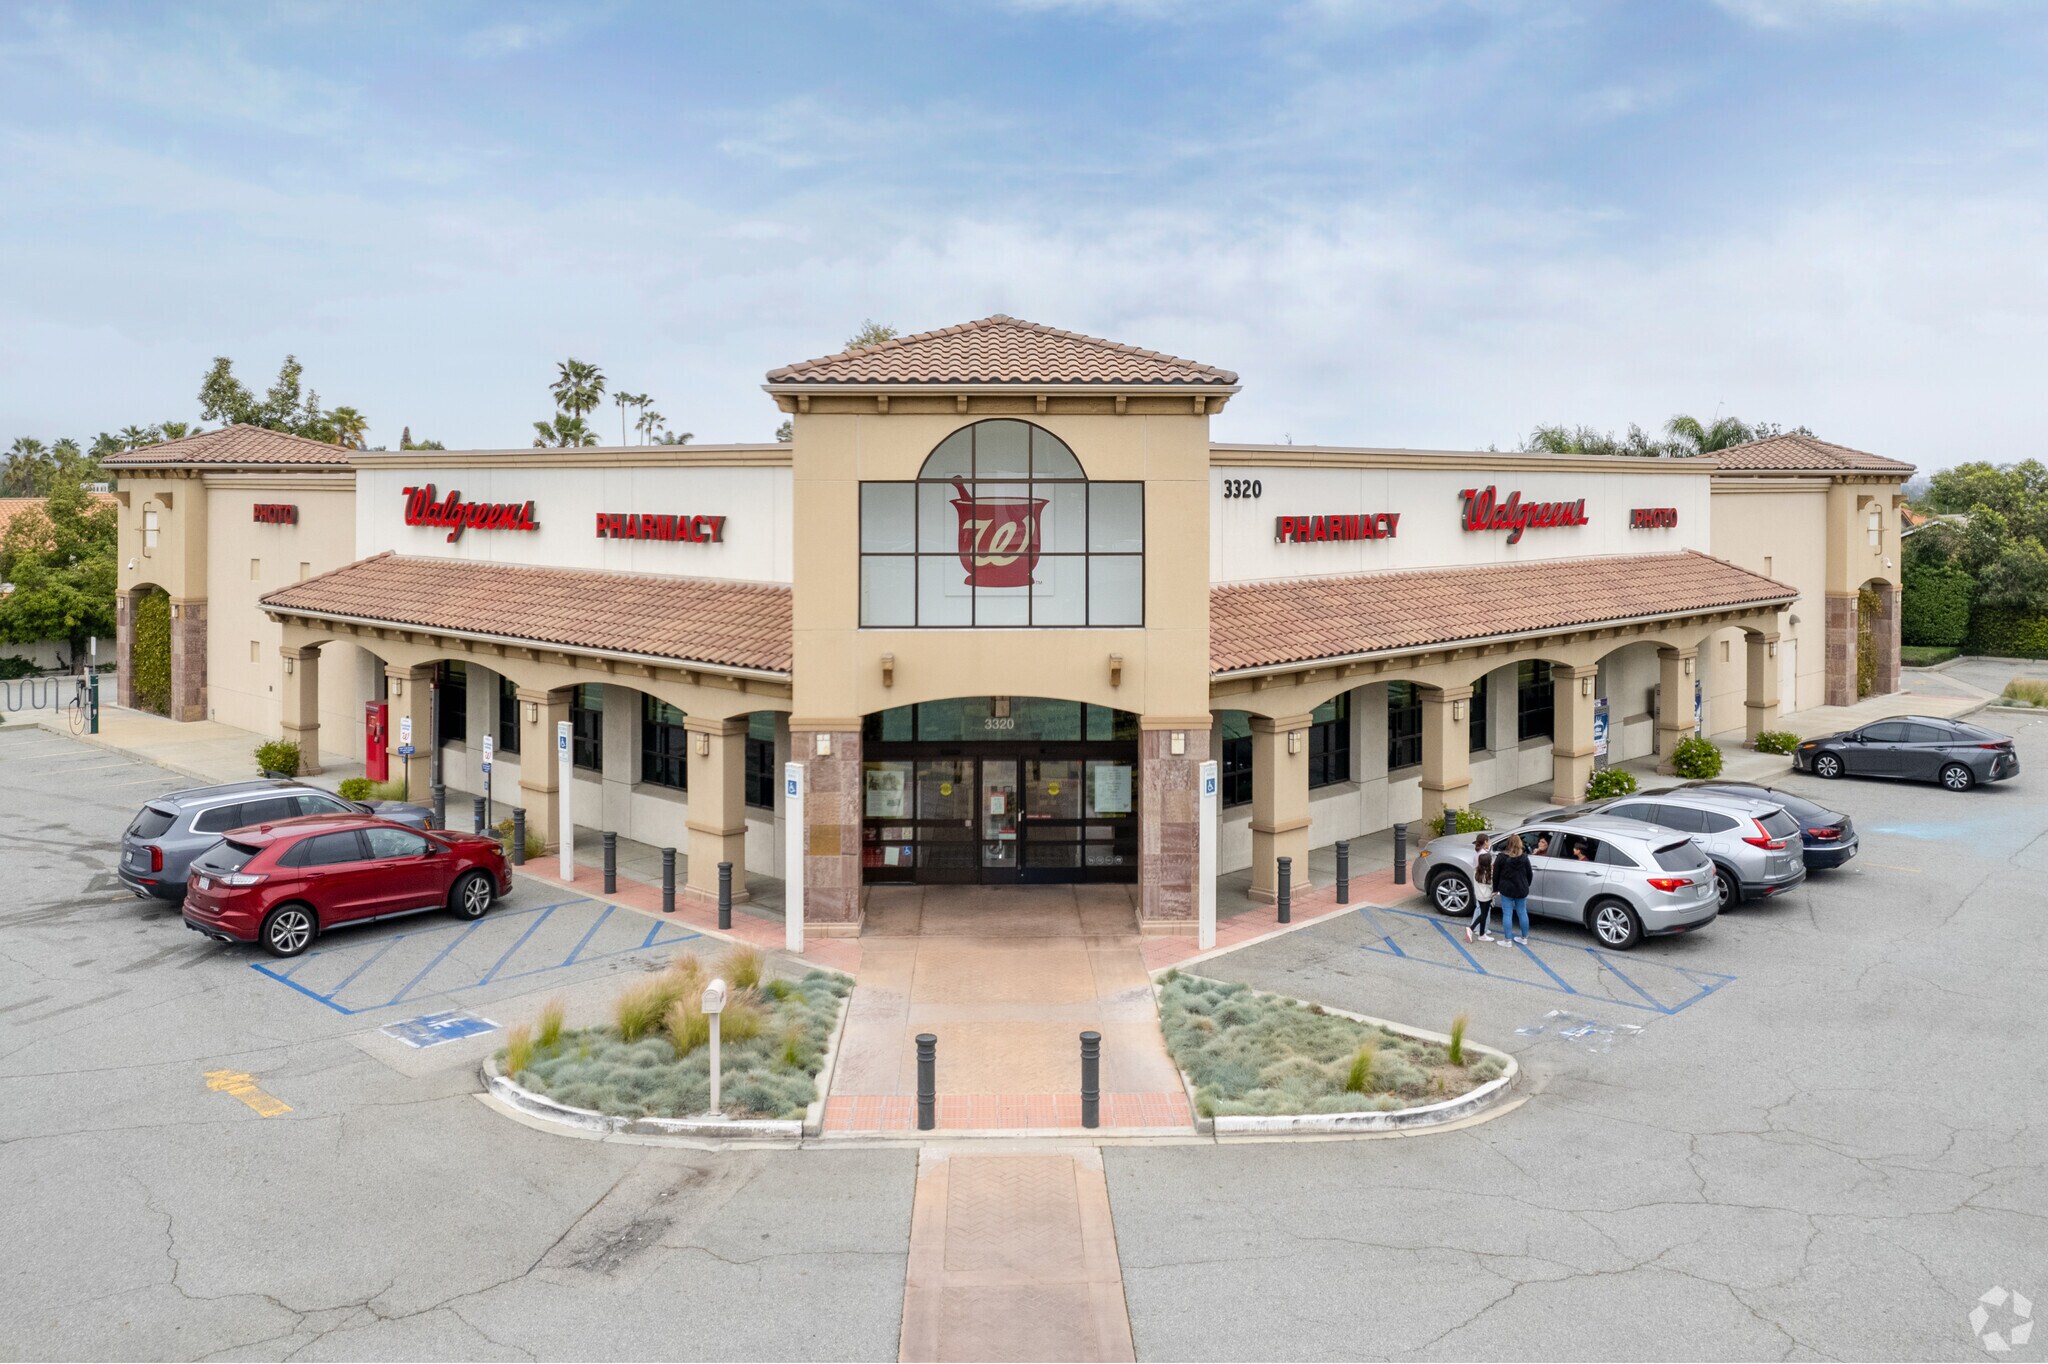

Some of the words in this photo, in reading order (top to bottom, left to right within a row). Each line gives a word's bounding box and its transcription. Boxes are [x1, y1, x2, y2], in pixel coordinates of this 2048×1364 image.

[1224, 480, 1262, 499] 3320
[253, 503, 298, 525] PHOTO
[402, 483, 539, 543] Walgreens
[1459, 485, 1589, 544] Walgreens
[1630, 508, 1678, 528] PHOTO
[596, 512, 725, 543] PHARMACY
[1276, 512, 1400, 543] PHARMACY
[984, 718, 1015, 730] 3320
